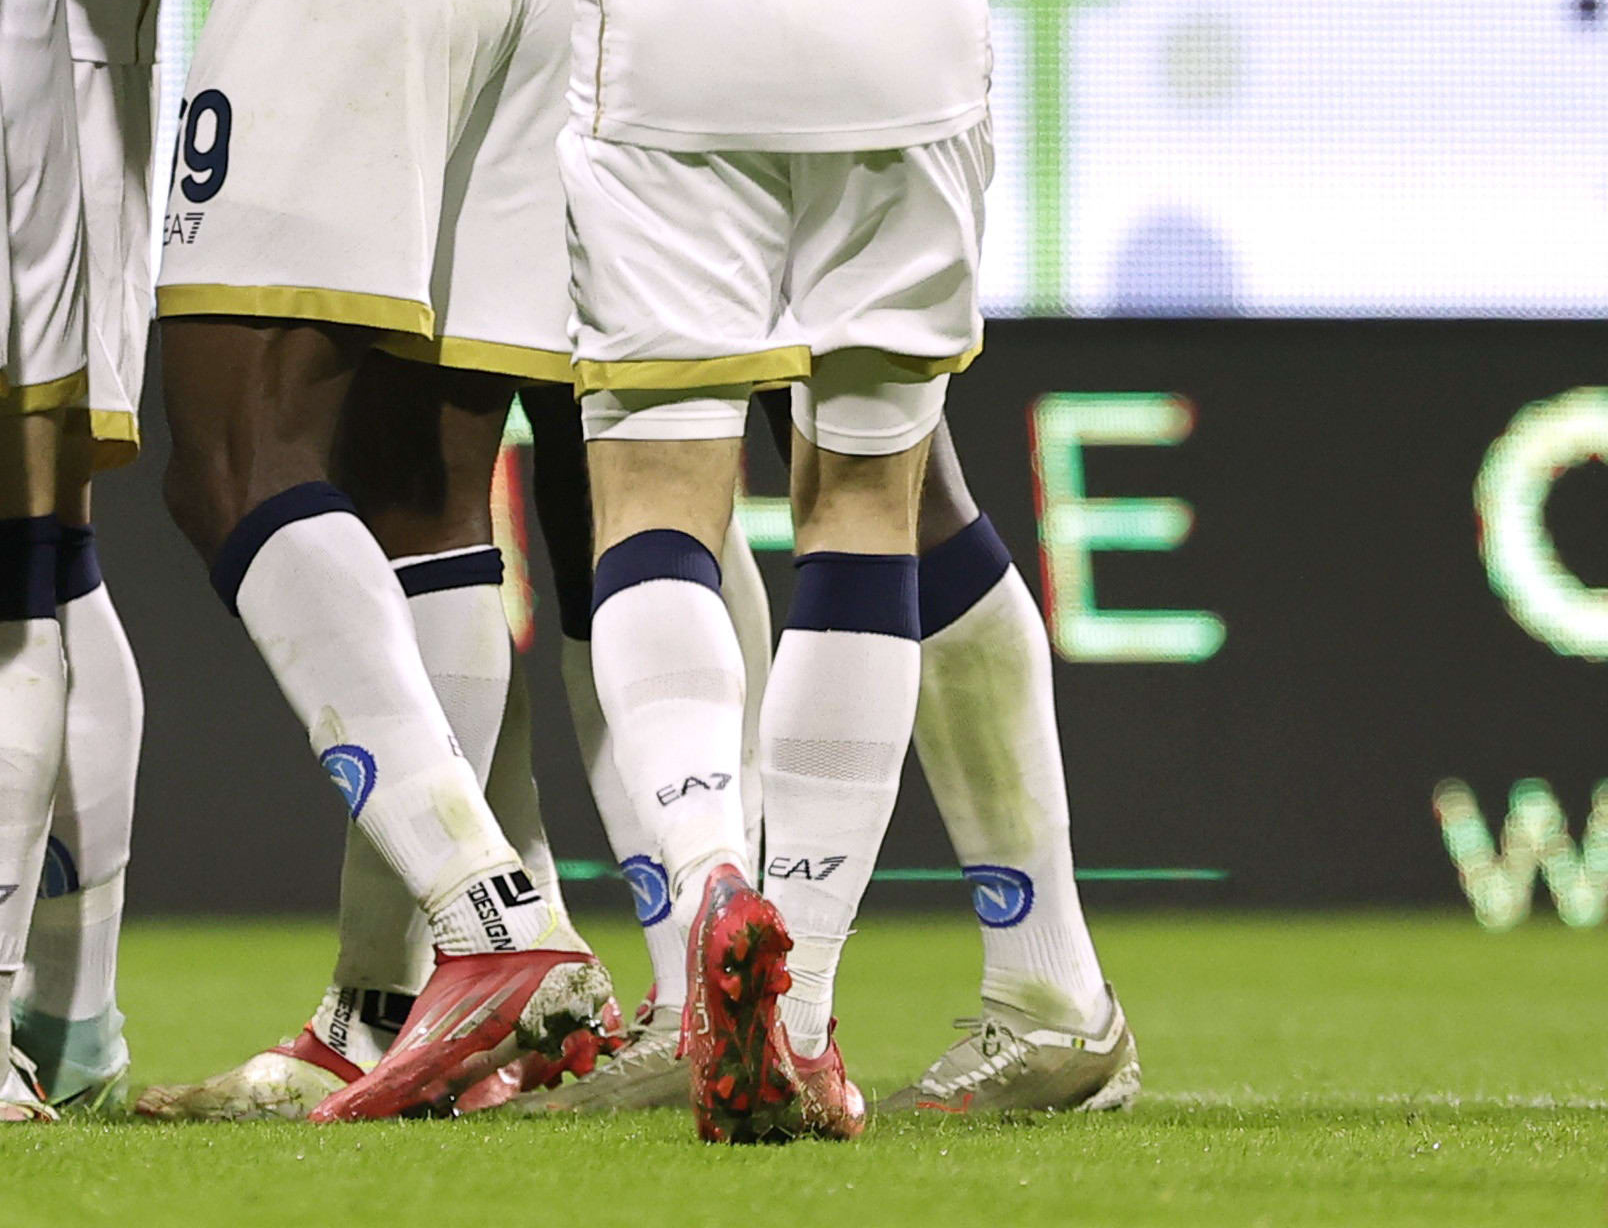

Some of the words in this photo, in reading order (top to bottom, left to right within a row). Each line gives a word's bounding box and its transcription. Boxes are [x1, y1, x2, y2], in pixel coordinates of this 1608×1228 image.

[169, 89, 234, 204] 9
[655, 772, 733, 808] EA7
[767, 855, 849, 881] EA7
